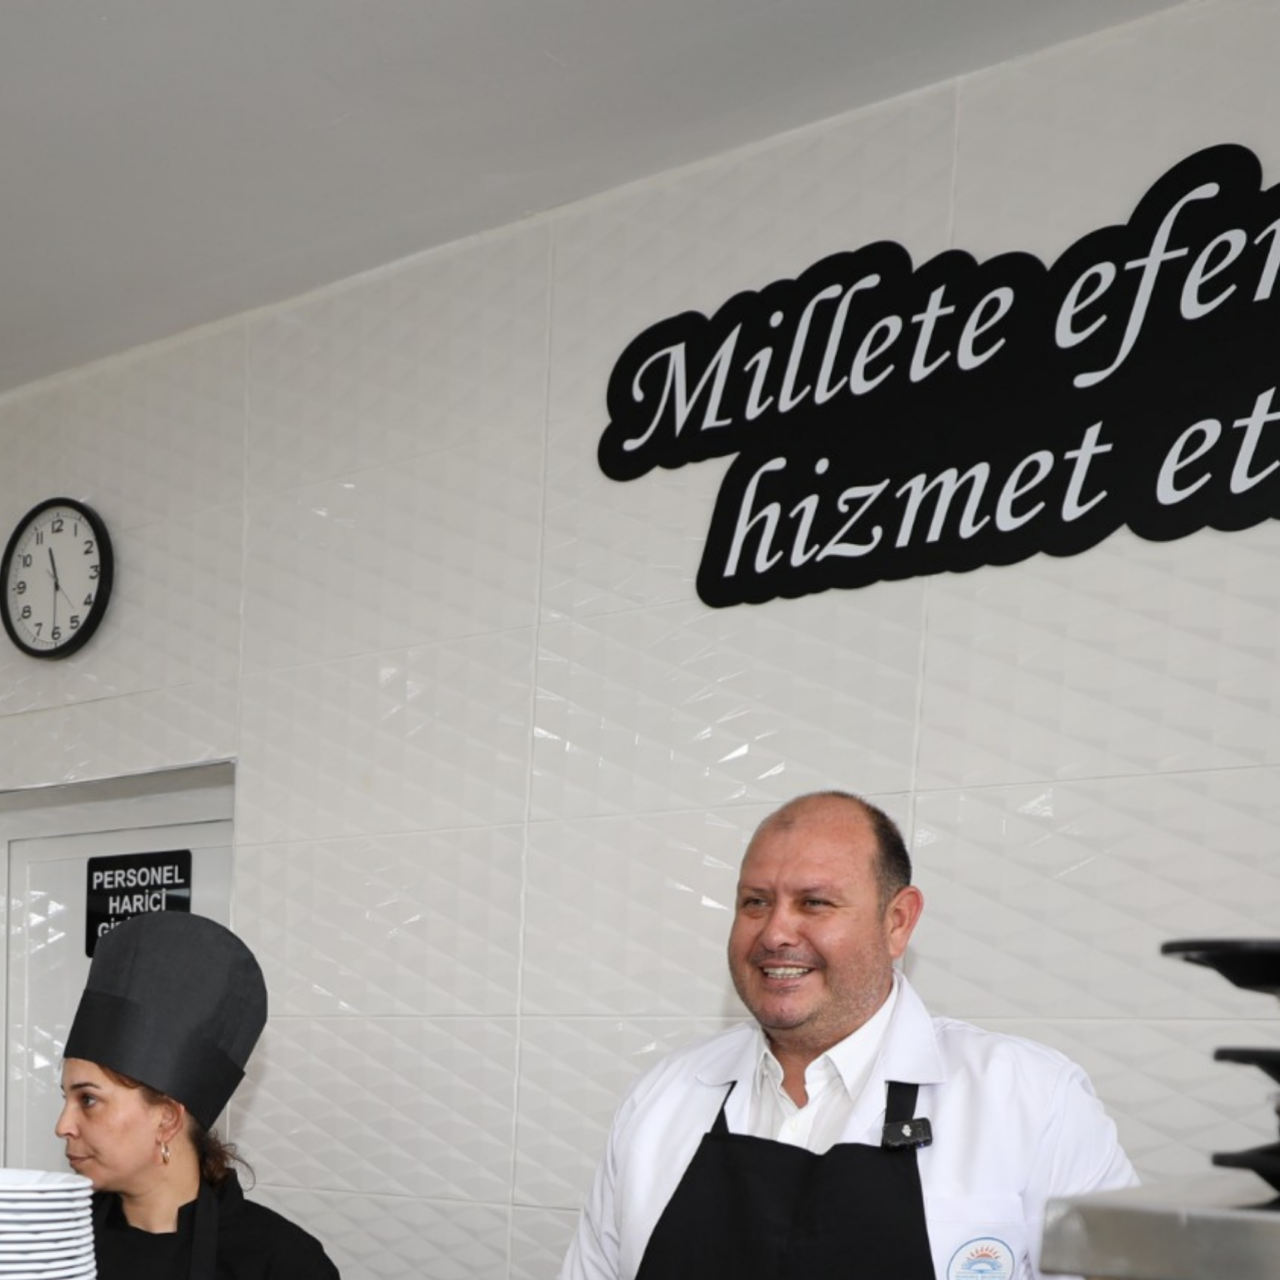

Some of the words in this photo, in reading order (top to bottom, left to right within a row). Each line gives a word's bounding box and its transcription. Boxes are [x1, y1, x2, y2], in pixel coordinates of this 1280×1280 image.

[623, 274, 1014, 452] Millete
[724, 420, 1113, 578] hizmet
[51, 519, 64, 534] 12
[36, 531, 44, 546] 11
[83, 540, 94, 555] 2
[22, 553, 33, 568] 10
[89, 565, 100, 580] 3
[16, 581, 27, 595] 9
[83, 593, 93, 606] 4
[21, 605, 32, 619] 8
[34, 622, 43, 637] 7
[69, 615, 80, 630] 5
[51, 626, 62, 640] 6
[92, 864, 185, 891] PERSONEL
[108, 887, 167, 915] HARİCİ
